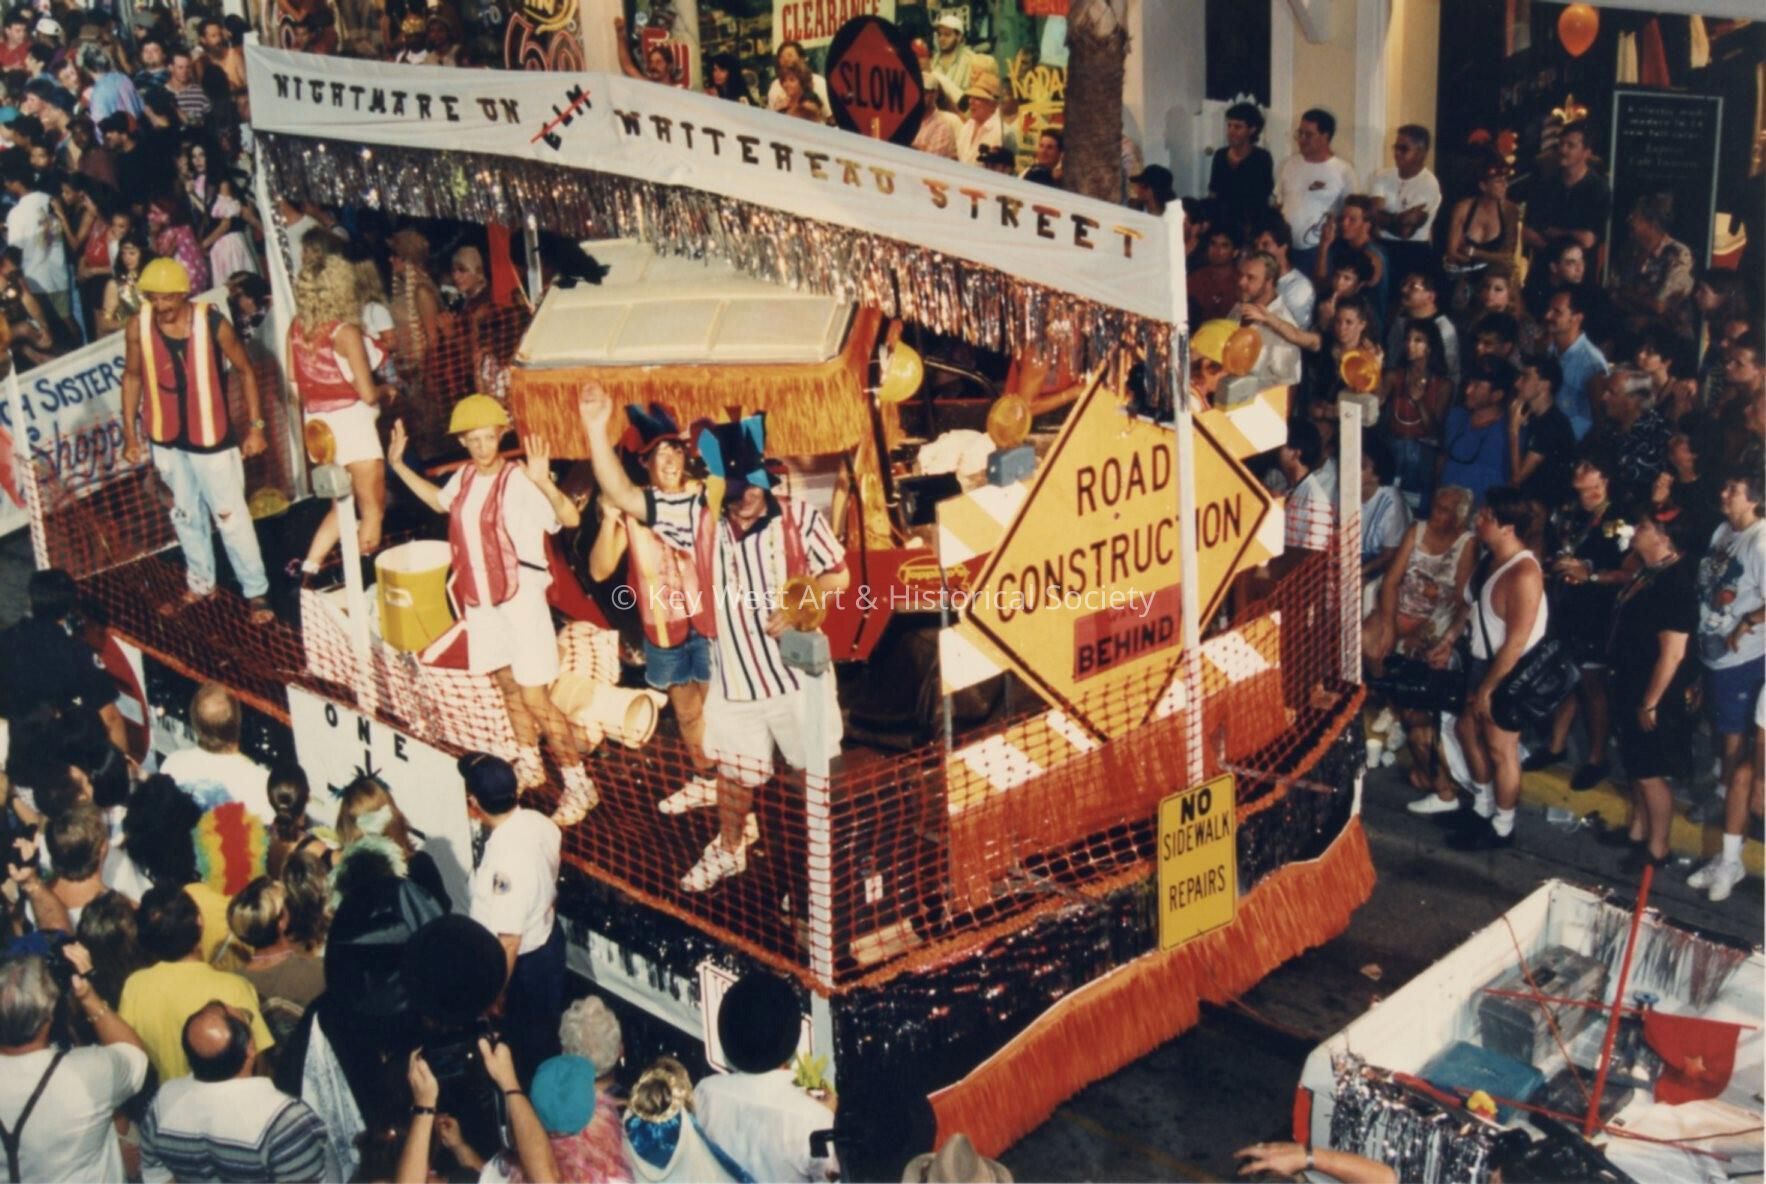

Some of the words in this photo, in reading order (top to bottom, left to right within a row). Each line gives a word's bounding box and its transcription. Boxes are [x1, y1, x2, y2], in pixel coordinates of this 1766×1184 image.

[839, 59, 907, 113] SLOW
[273, 73, 459, 121] NIGHTMARE
[922, 178, 1144, 258] STREET
[1076, 443, 1172, 517] ROAD
[997, 493, 1242, 623] CONSTRUCION
[1079, 615, 1173, 674] BEHIND
[324, 702, 409, 763] ONE
[1163, 810, 1231, 862] SIDEWALK
[1181, 788, 1212, 825] NO
[1169, 864, 1227, 912] REPAIRS
